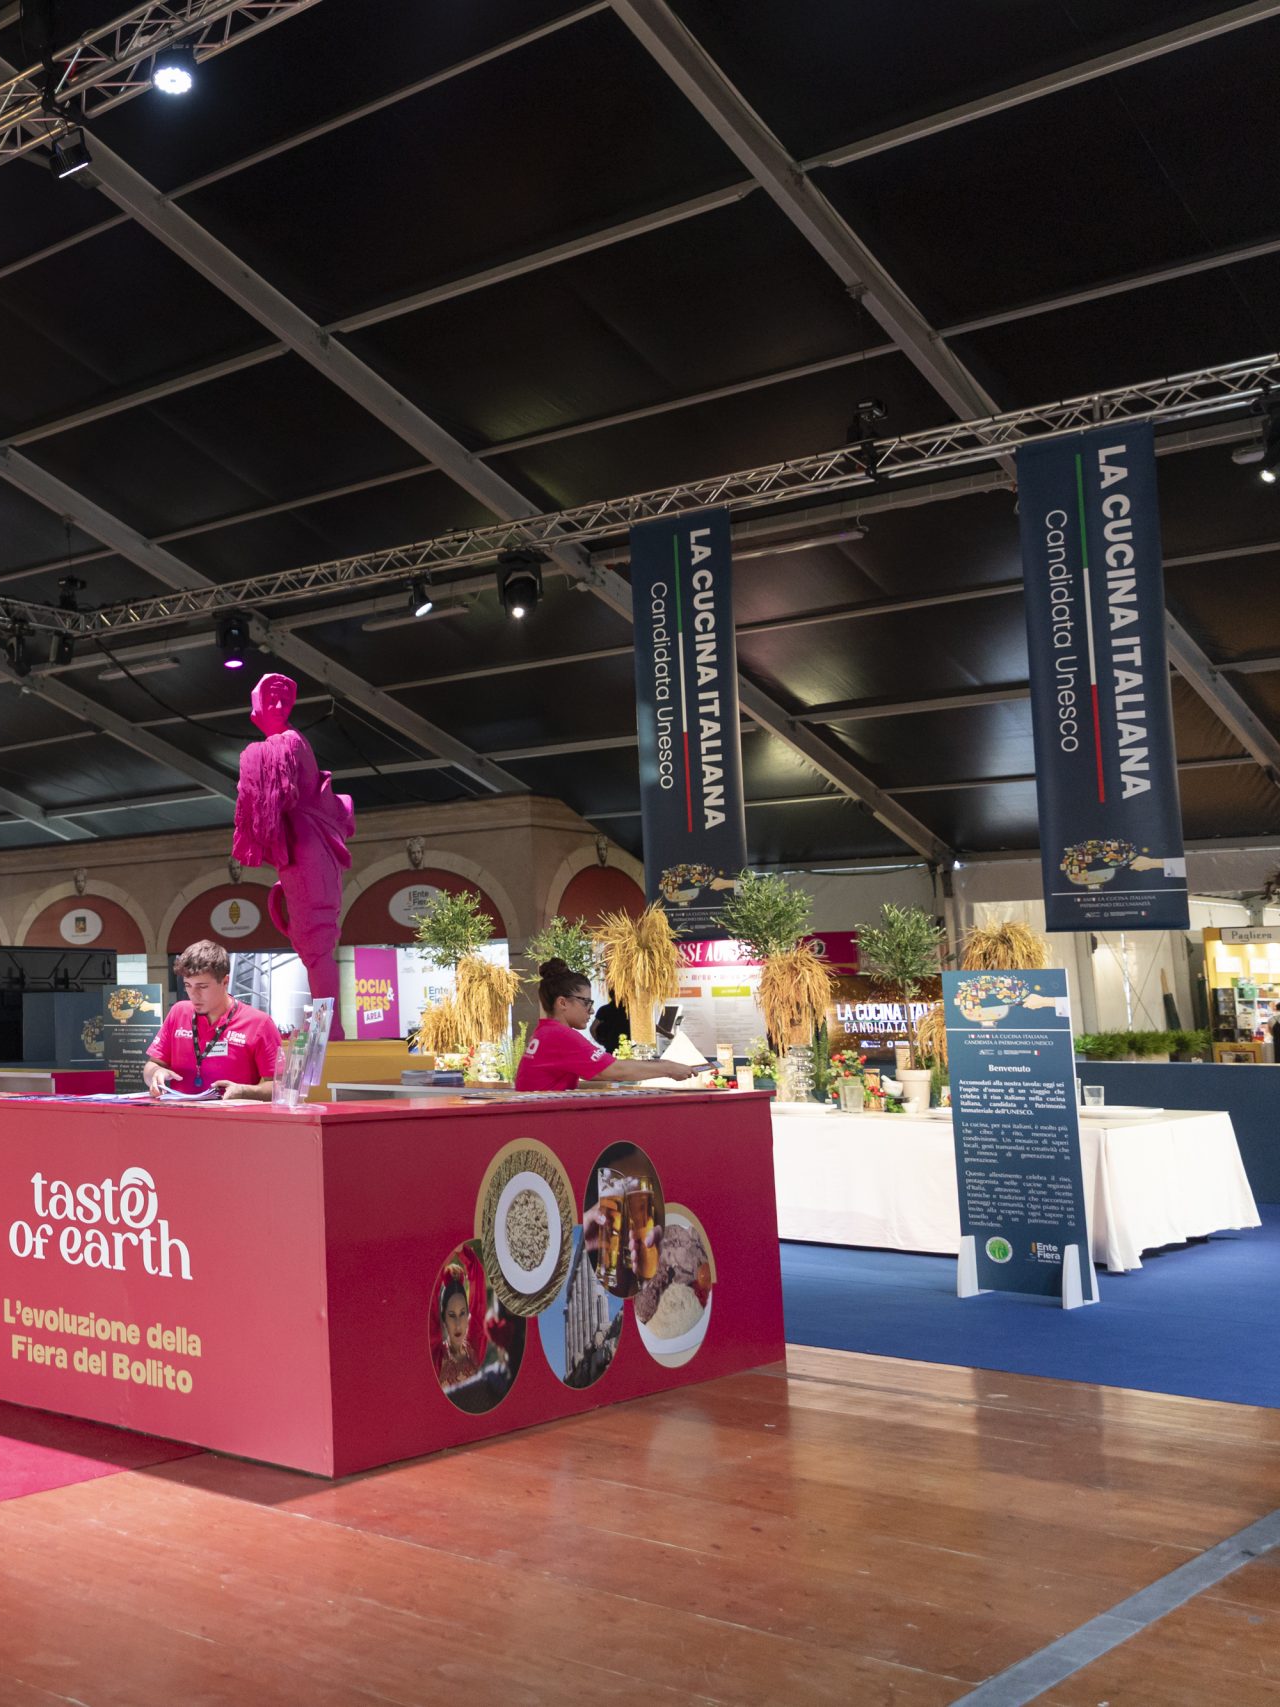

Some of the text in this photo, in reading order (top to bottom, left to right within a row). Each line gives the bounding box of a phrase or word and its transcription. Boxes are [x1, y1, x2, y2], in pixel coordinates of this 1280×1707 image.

[1045, 509, 1079, 752] Candidata Unesco
[1098, 444, 1151, 800] LA CUCINA ITALIANA
[651, 581, 674, 790] Candidata Unesco
[689, 527, 726, 830] LA CUCINA ITALIANA
[356, 996, 391, 1011] PRESS
[836, 1003, 853, 1021] LA
[855, 1003, 904, 1021] CUCINA
[844, 1021, 908, 1033] CANDIDATA
[988, 1064, 1031, 1073] Benvenuto
[30, 1167, 159, 1229] taste
[8, 1219, 193, 1280] of earth
[1037, 1242, 1059, 1252] Ente
[1037, 1250, 1061, 1260] Fiera
[3, 1298, 202, 1358] L'evoluzione della
[11, 1334, 193, 1394] Fiera del Bollito
